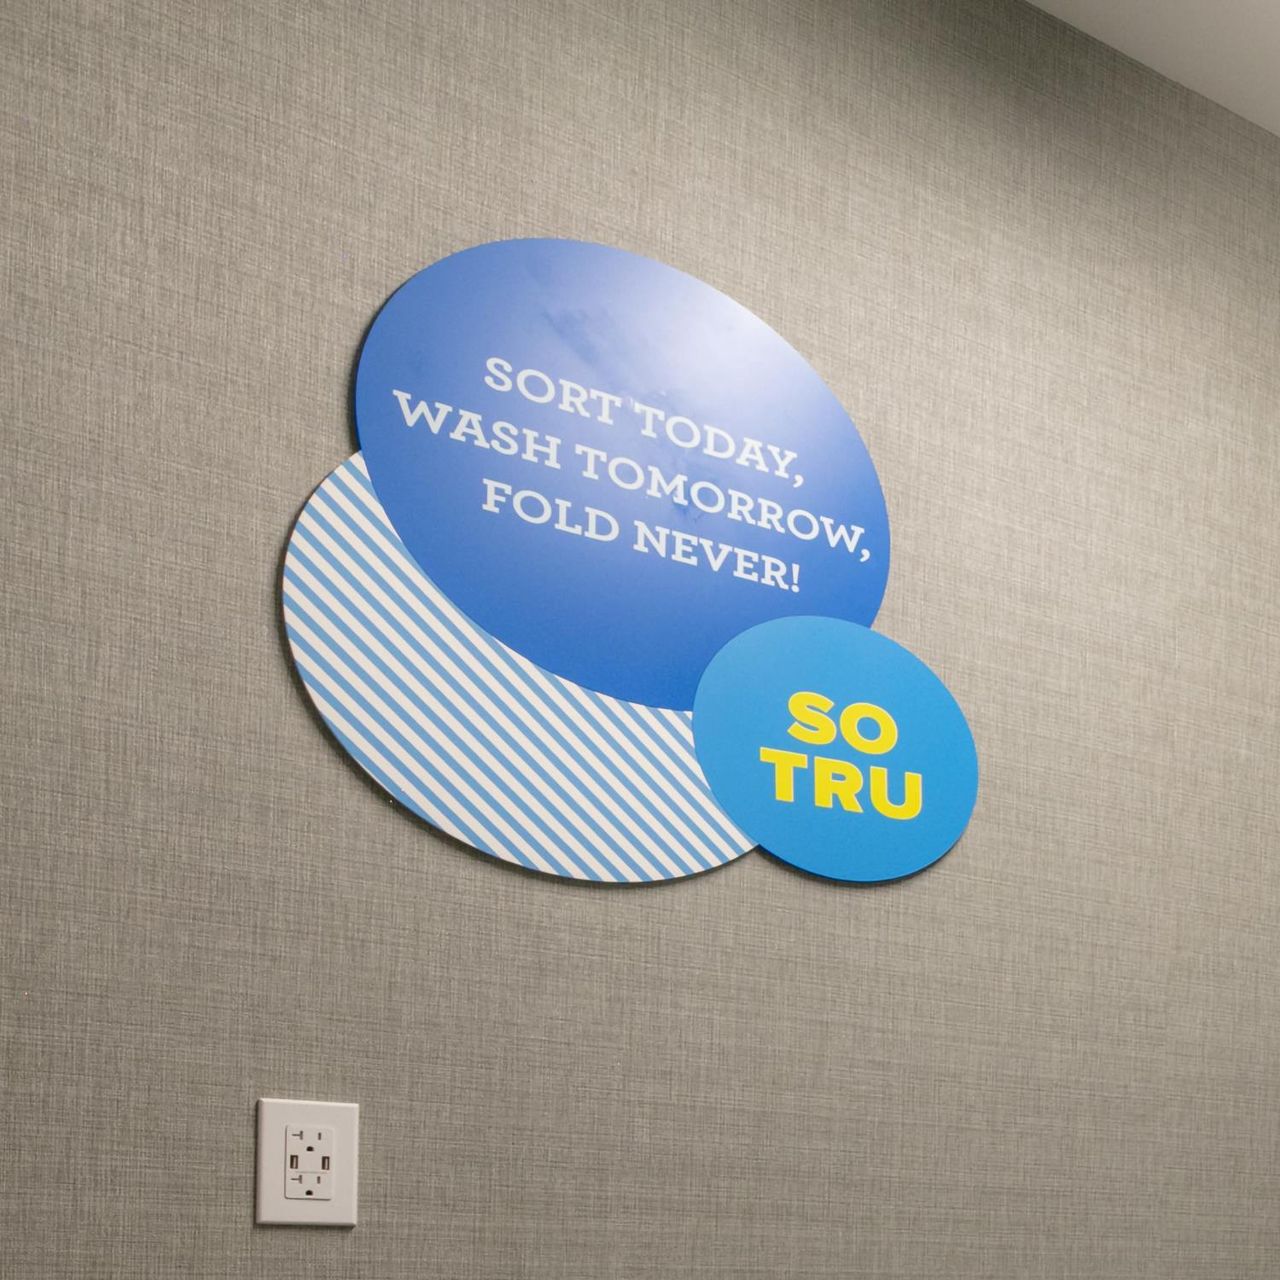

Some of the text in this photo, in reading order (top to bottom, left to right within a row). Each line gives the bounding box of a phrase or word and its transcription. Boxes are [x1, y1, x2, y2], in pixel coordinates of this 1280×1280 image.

[393, 390, 871, 563] WASH TOMORROW,
[484, 357, 804, 489] SORT TODAY,
[481, 478, 801, 593] FOLD NEVER!
[787, 691, 898, 755] SO
[760, 747, 922, 820] TRU
